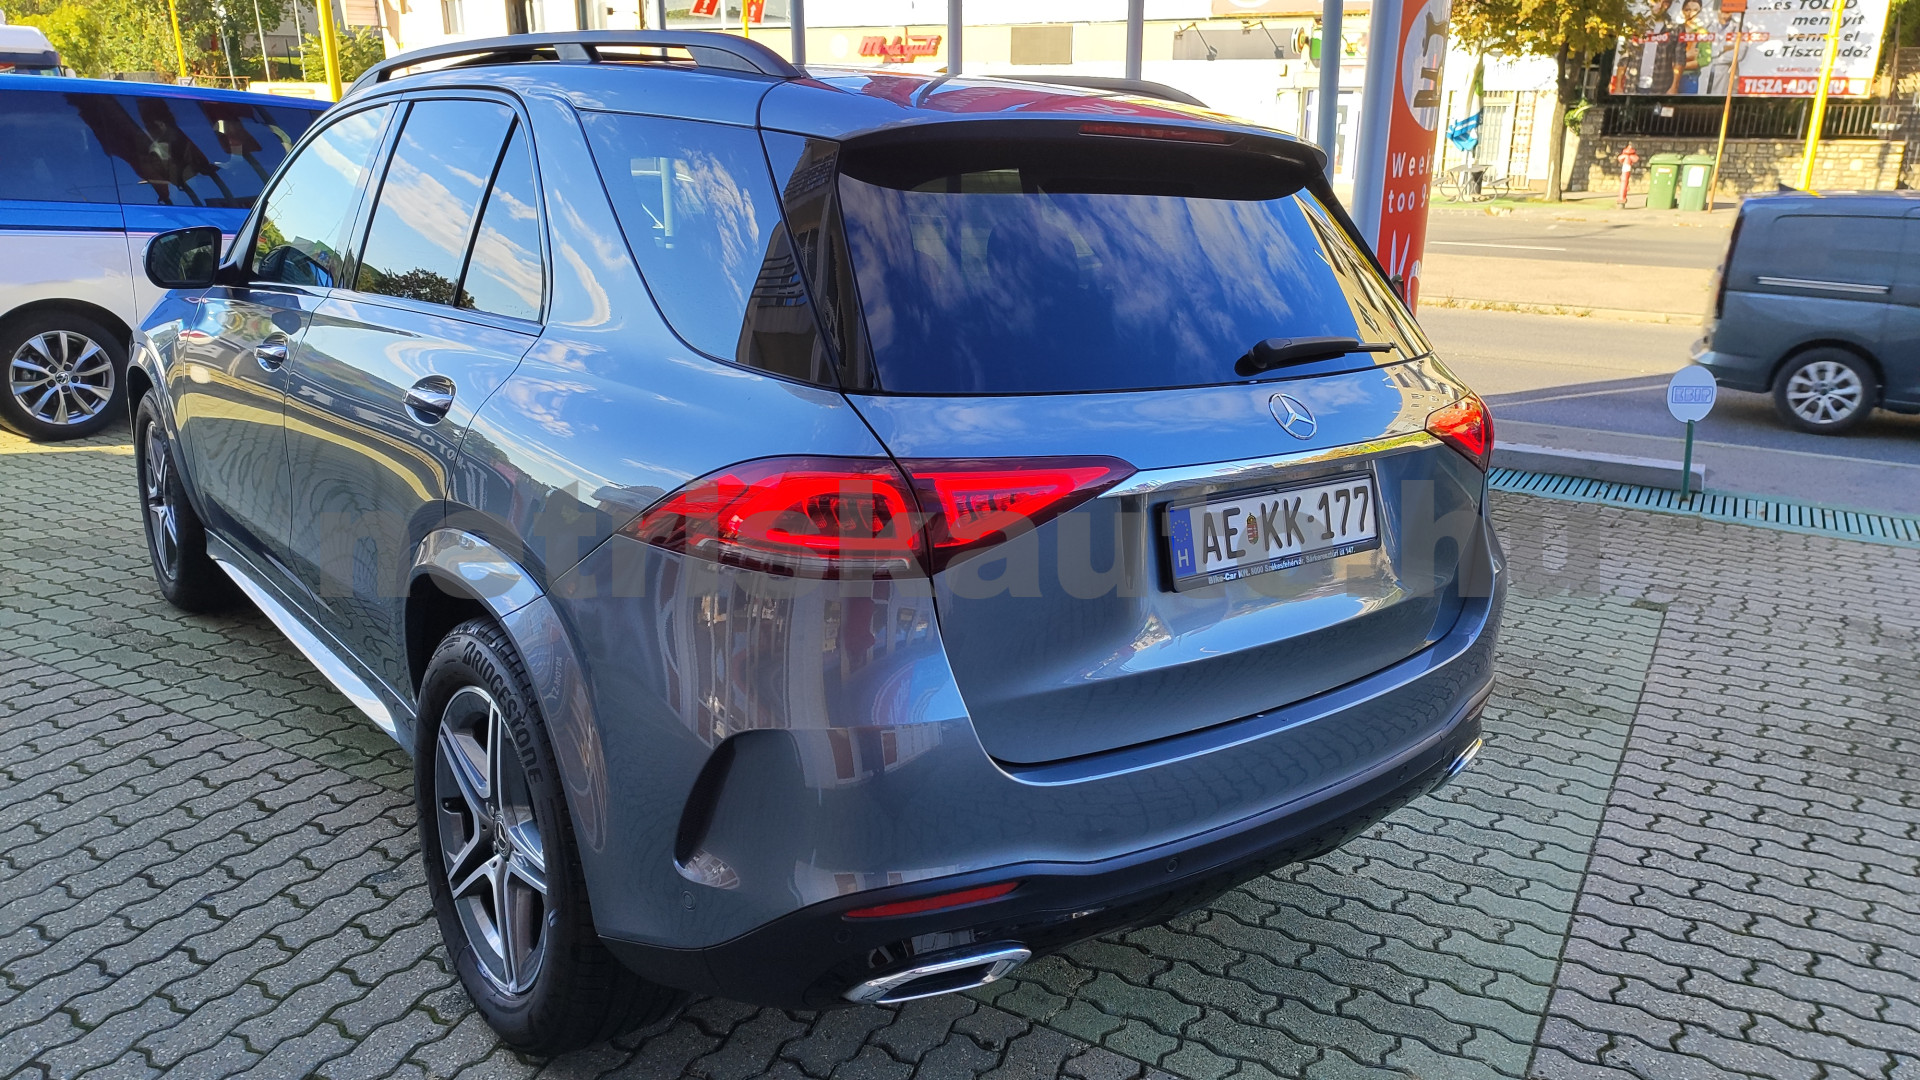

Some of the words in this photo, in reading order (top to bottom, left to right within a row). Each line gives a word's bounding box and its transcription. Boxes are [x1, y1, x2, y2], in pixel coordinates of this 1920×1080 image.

[1844, 31, 1860, 42] el
[1388, 189, 1415, 213] too
[1177, 548, 1190, 568] H
[1208, 572, 1237, 584] Bike-Car
[462, 641, 543, 785] BRIDGESTONE
